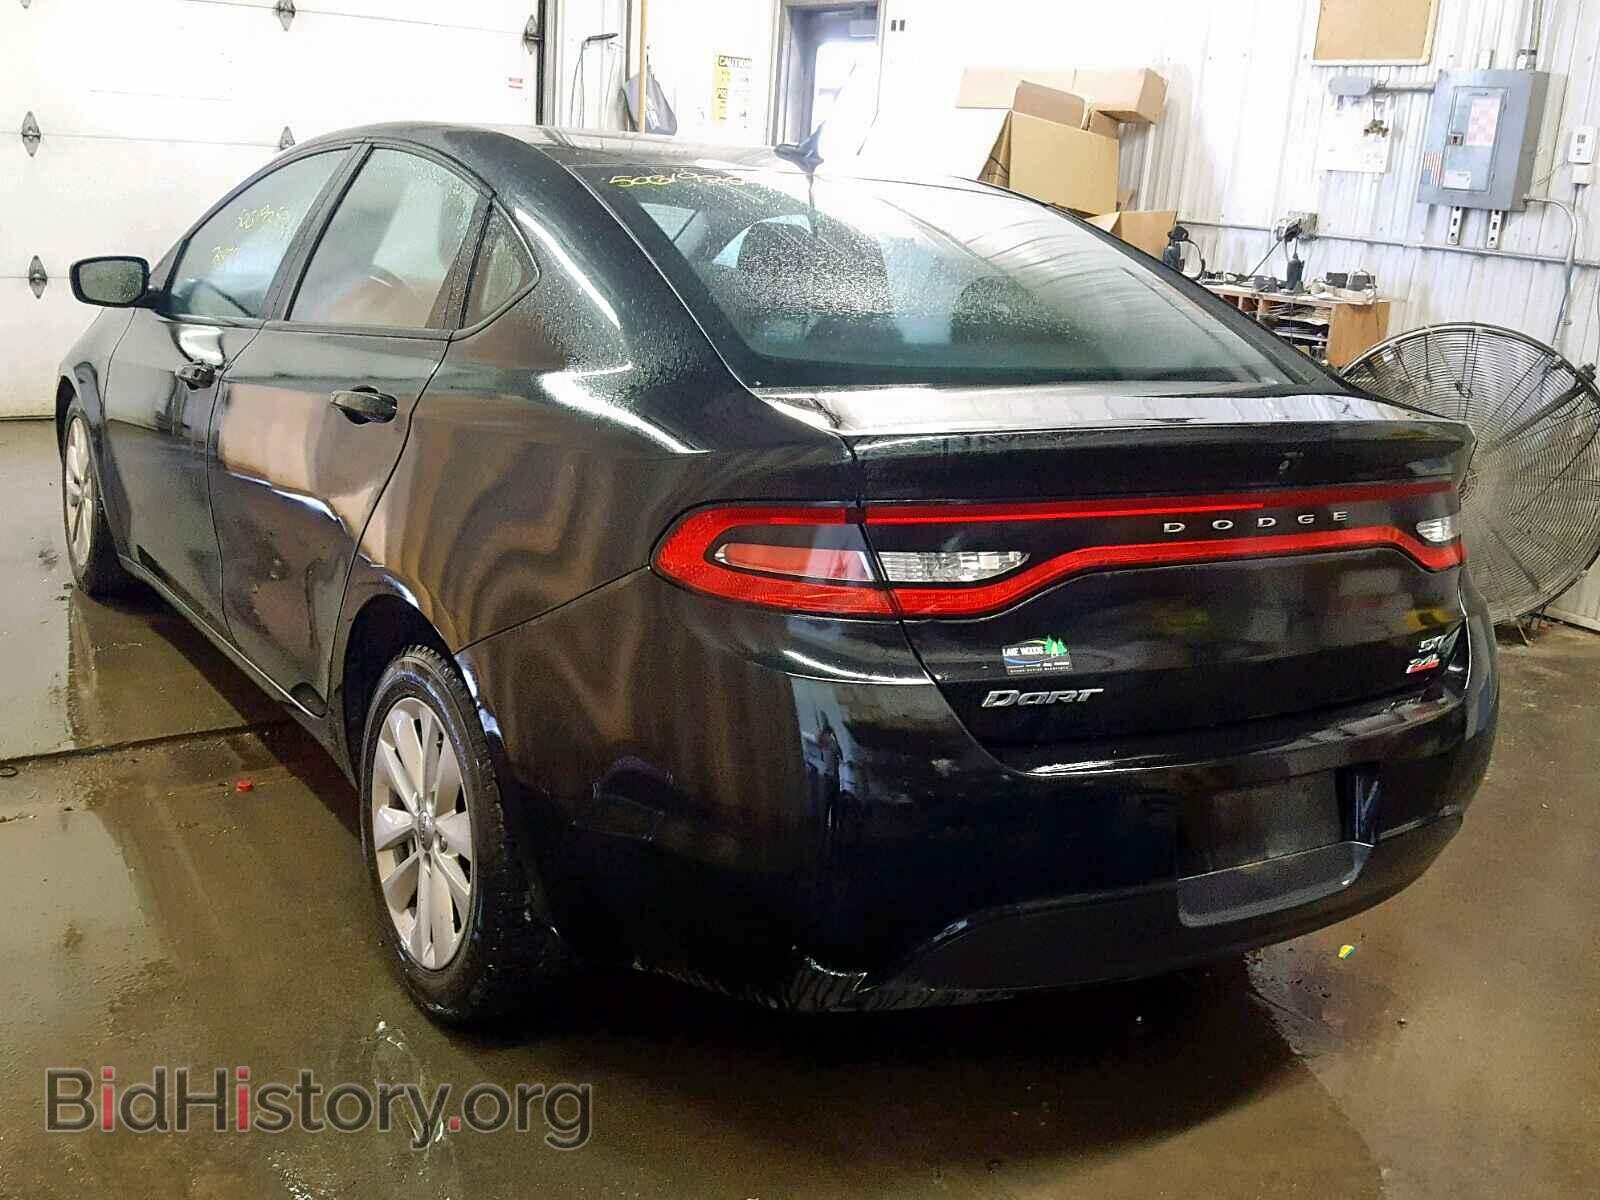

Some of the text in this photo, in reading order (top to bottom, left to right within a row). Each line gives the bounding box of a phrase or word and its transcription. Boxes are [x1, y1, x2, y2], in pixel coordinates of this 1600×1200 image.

[1163, 510, 1348, 533] DODGE
[1002, 646, 1044, 657] LAKE WOODS
